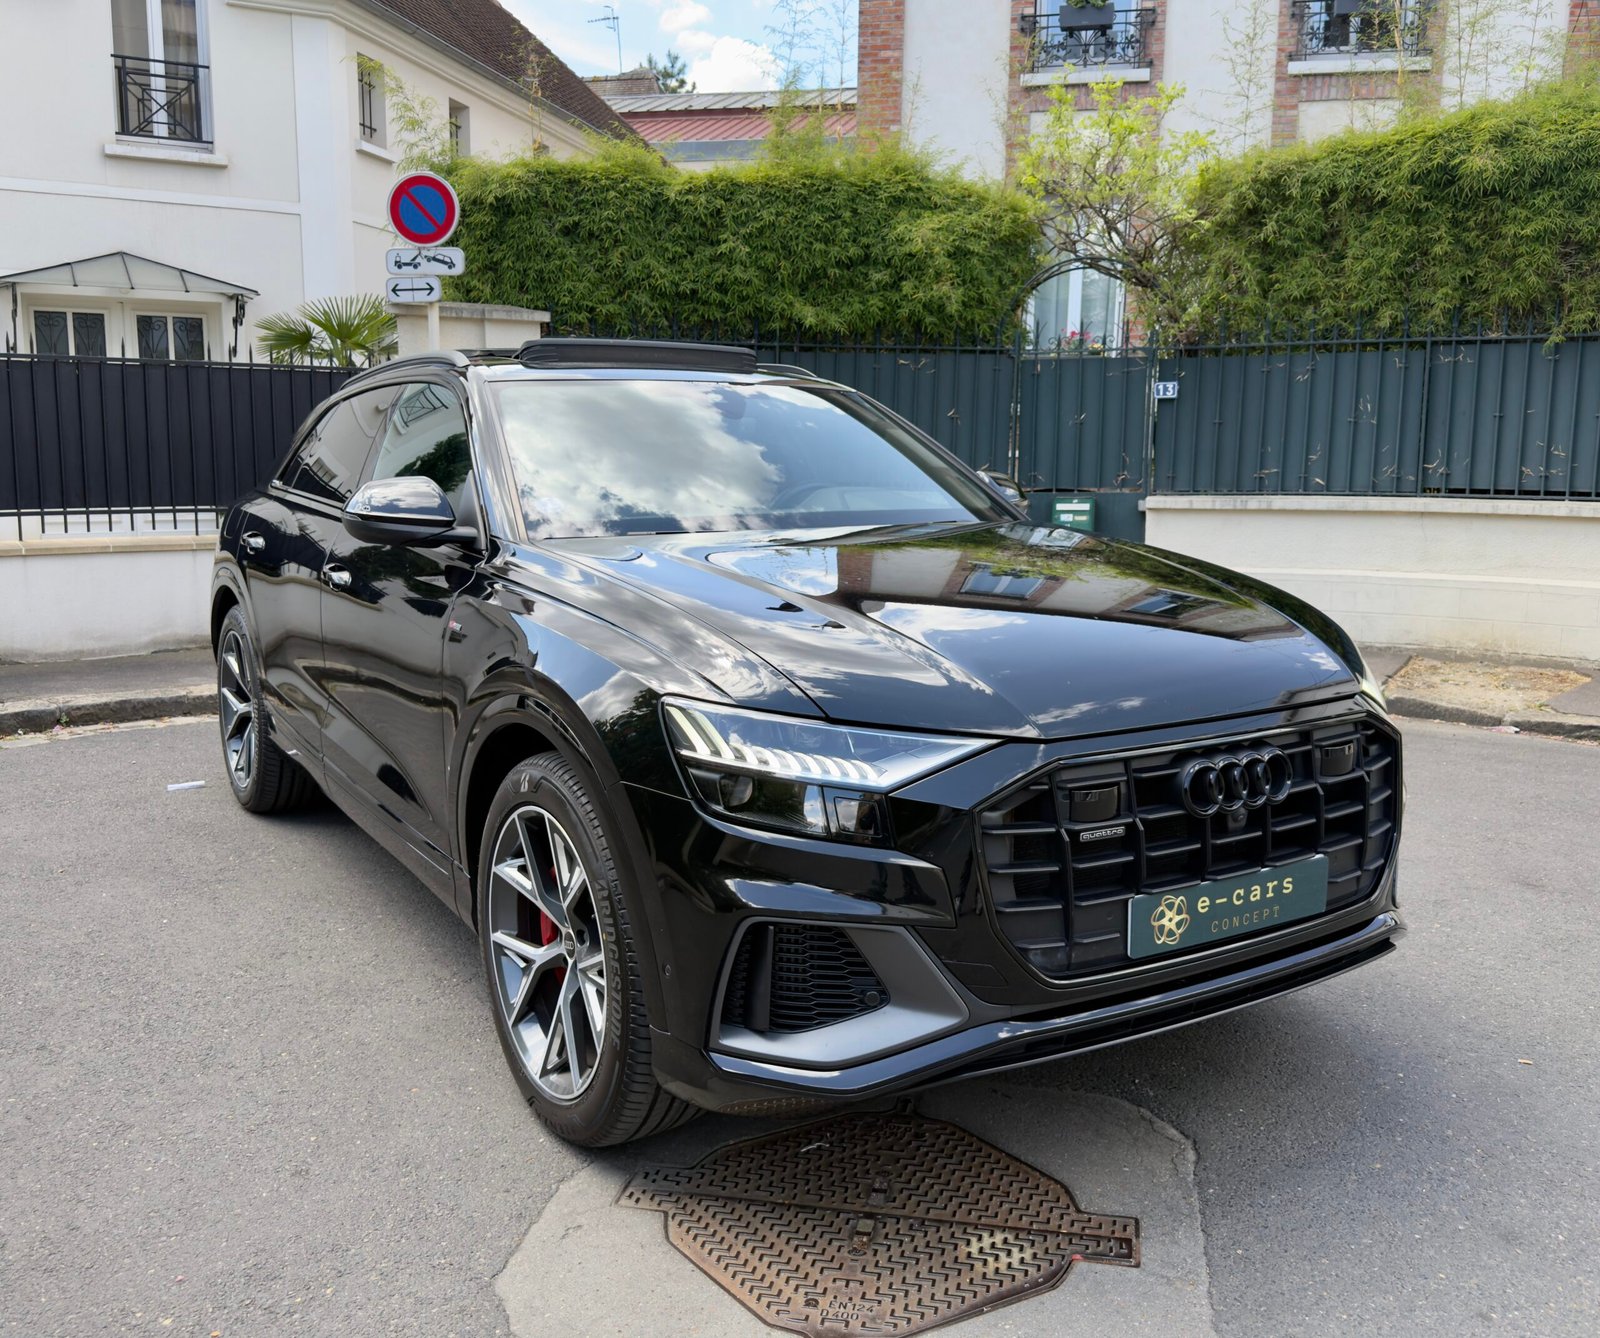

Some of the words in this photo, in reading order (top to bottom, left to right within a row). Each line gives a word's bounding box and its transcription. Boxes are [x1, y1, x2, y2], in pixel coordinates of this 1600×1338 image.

[1158, 384, 1174, 396] 13
[1082, 828, 1124, 840] quattro
[1197, 875, 1294, 913] e-cars
[1211, 906, 1280, 933] CONCEPT
